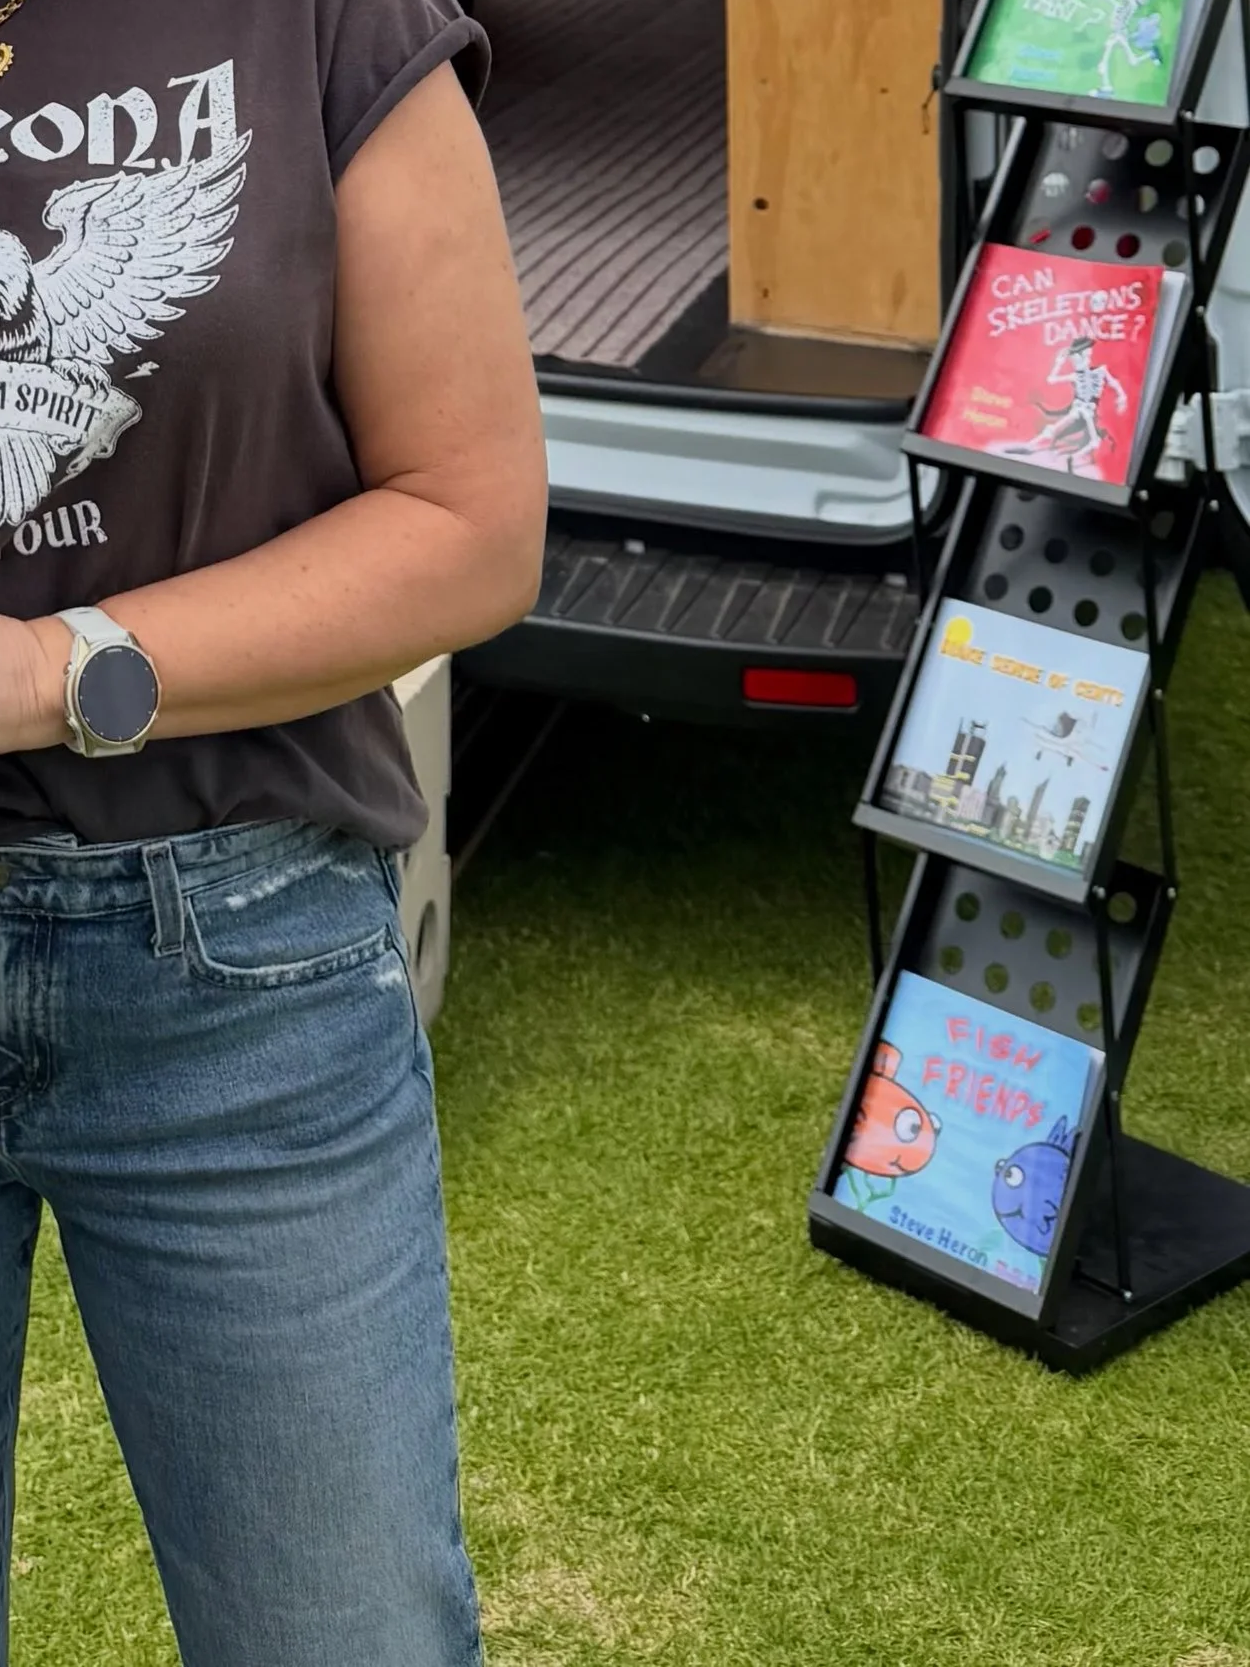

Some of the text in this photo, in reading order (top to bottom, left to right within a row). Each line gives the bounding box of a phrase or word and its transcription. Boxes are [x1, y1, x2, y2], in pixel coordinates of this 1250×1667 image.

[987, 281, 1144, 338] SKELETONS
[991, 267, 1054, 299] CAN
[14, 383, 103, 433] SPIRIT
[946, 1017, 1043, 1072] FISH
[922, 1057, 1047, 1129] FRIENDS
[889, 1205, 989, 1267] Steve Heron
